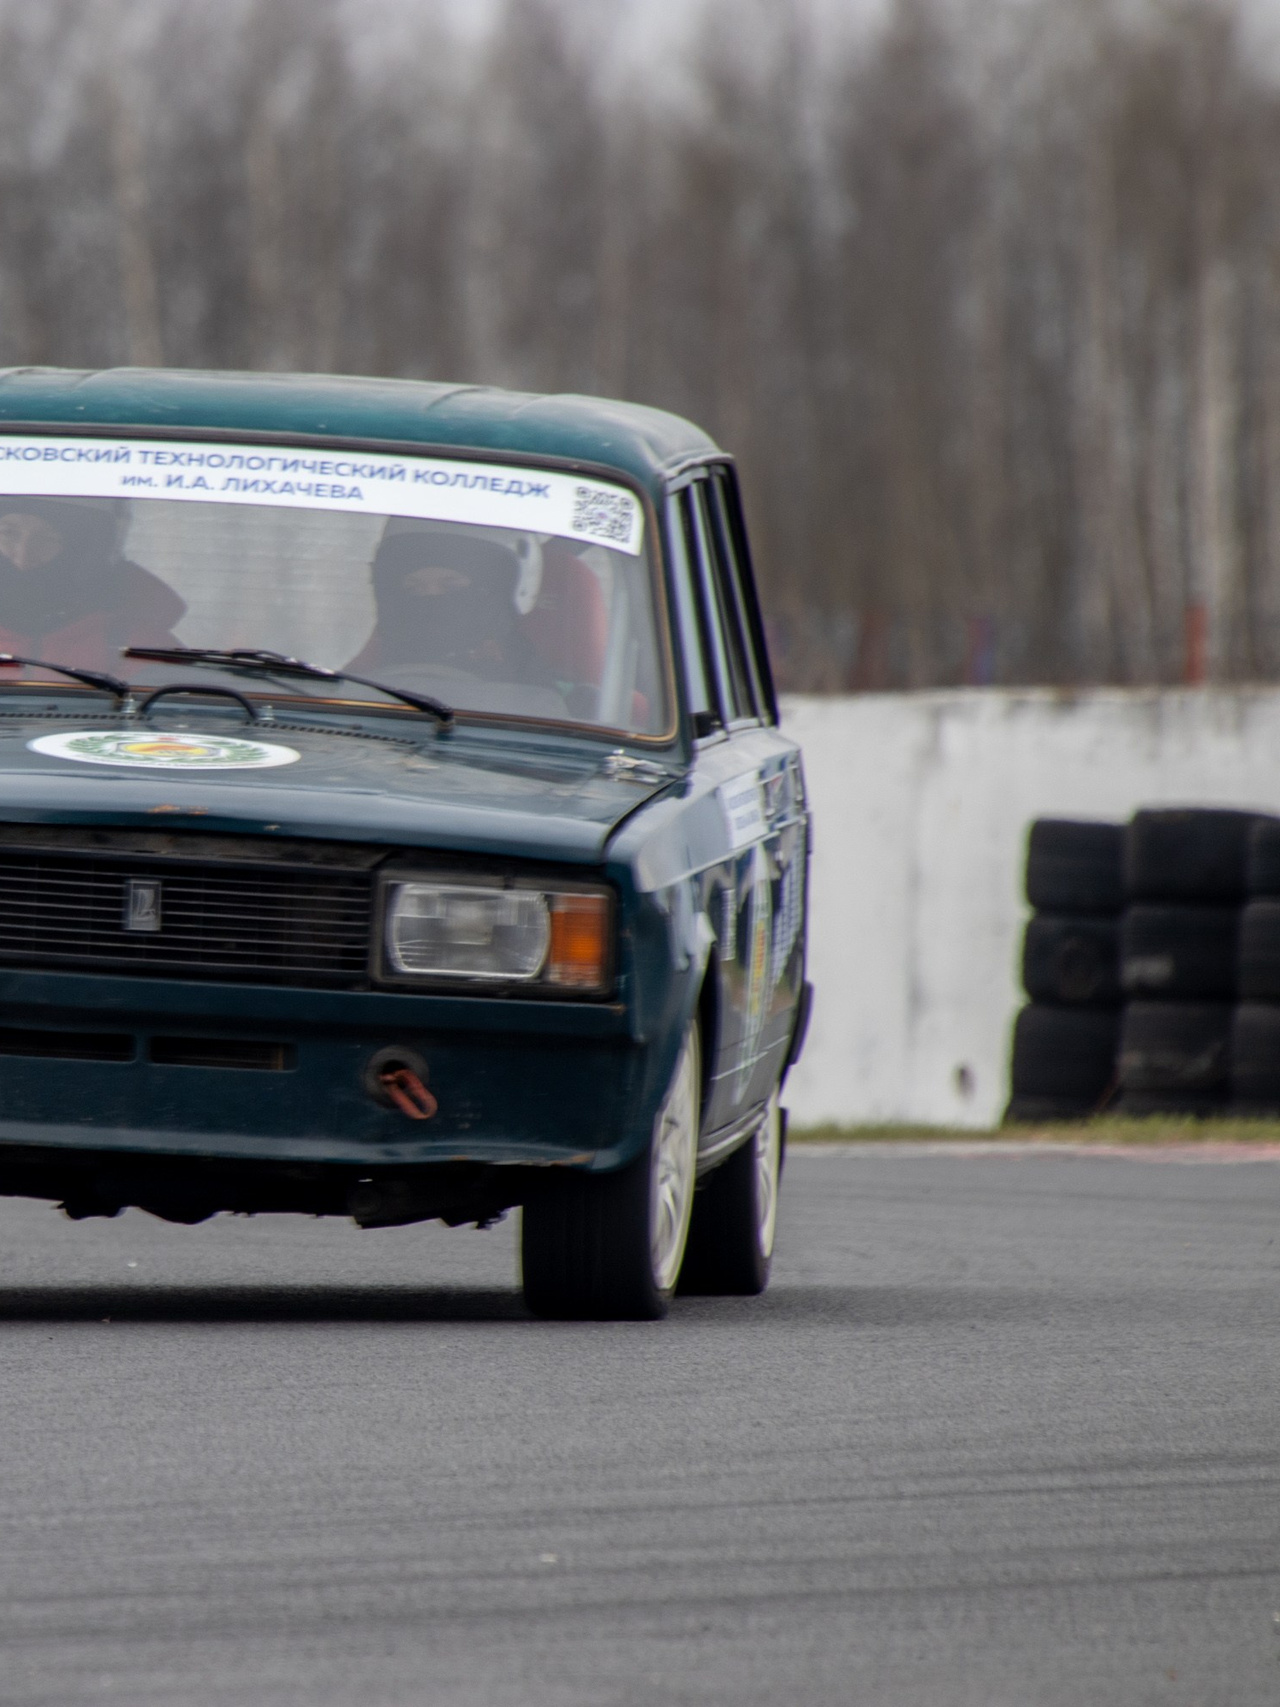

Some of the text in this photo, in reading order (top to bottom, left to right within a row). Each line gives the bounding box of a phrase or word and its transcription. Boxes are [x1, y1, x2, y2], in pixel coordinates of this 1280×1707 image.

[138, 450, 407, 481] ТЕХНОЛОГИЧЕСКИЙ
[412, 468, 551, 498] КОЛЛЕДЖ
[166, 474, 214, 490] И.А.
[220, 476, 365, 500] ЛИХАЧЕВА
